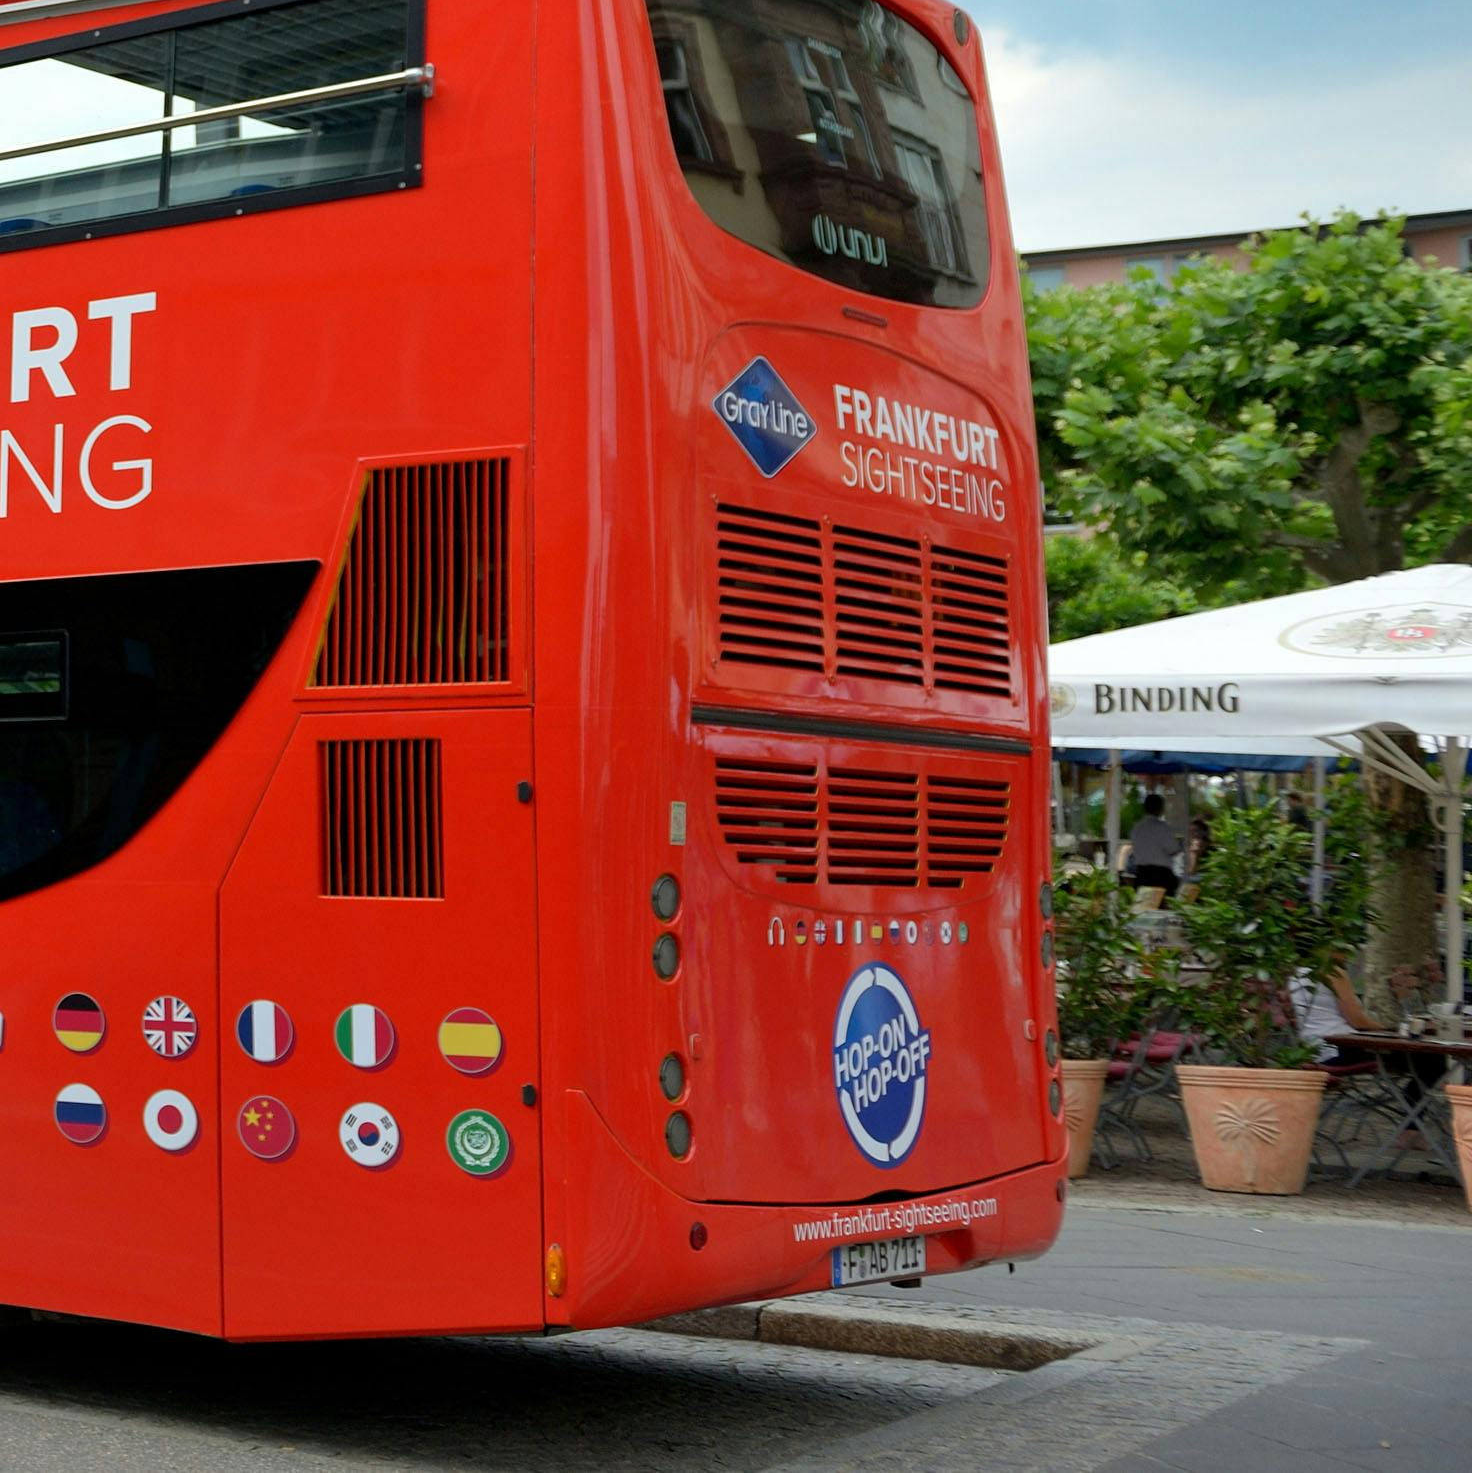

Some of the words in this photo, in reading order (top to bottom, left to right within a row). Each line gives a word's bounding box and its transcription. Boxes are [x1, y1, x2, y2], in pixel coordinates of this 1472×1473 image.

[833, 384, 999, 470] FRANKFURT
[841, 441, 1006, 522] SIGHTSEEING
[835, 1013, 905, 1088] HOP-ON
[853, 1032, 929, 1113] HOP-OFF
[793, 1197, 997, 1242] www.frankfurt-sightseeing.com
